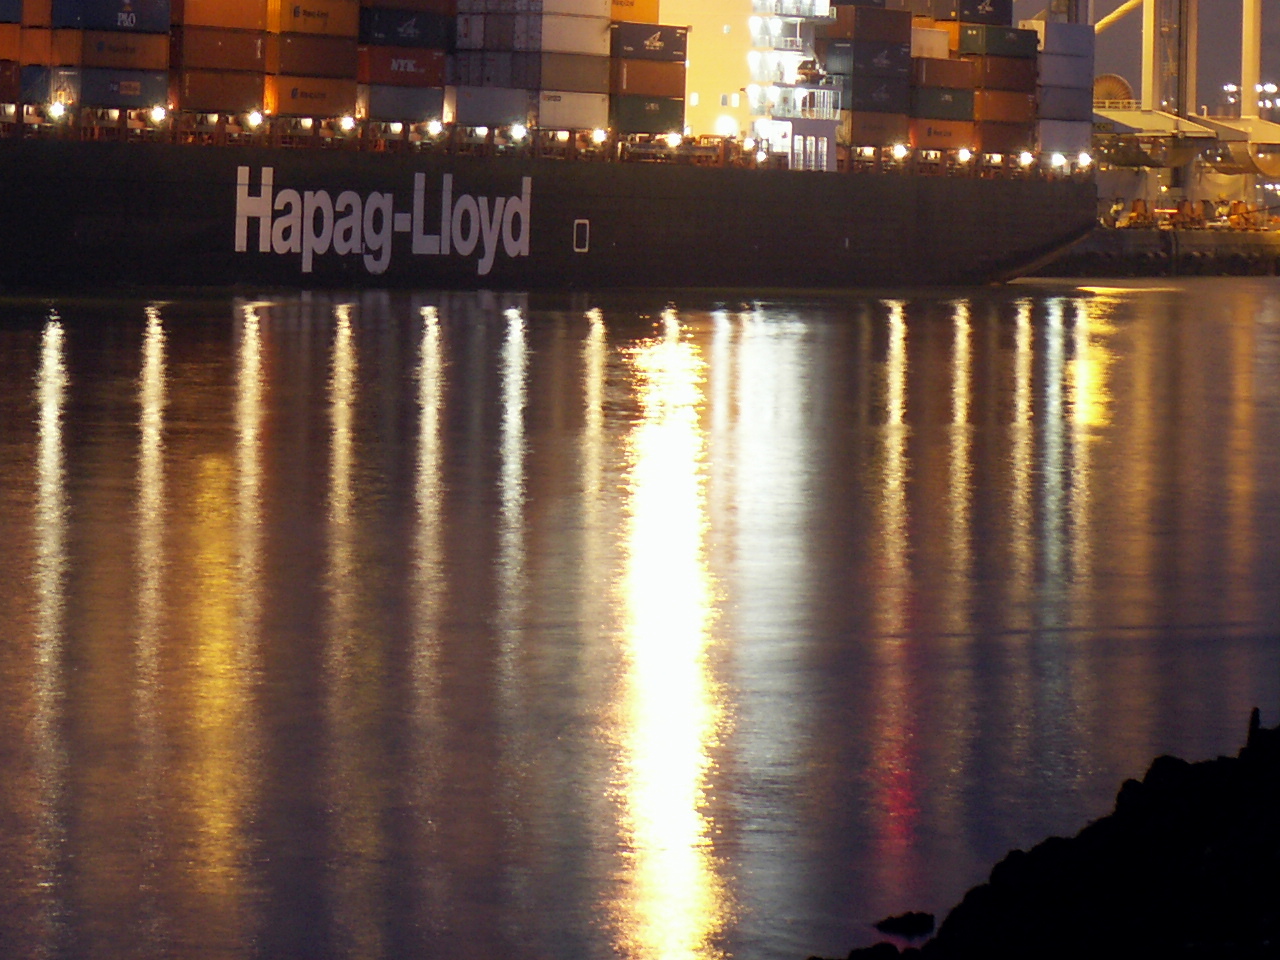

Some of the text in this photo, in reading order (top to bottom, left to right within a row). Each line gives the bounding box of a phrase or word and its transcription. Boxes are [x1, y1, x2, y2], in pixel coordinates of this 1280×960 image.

[117, 12, 136, 27] P&O
[390, 58, 416, 72] NYK
[235, 166, 531, 275] Hapag-Lloyd
